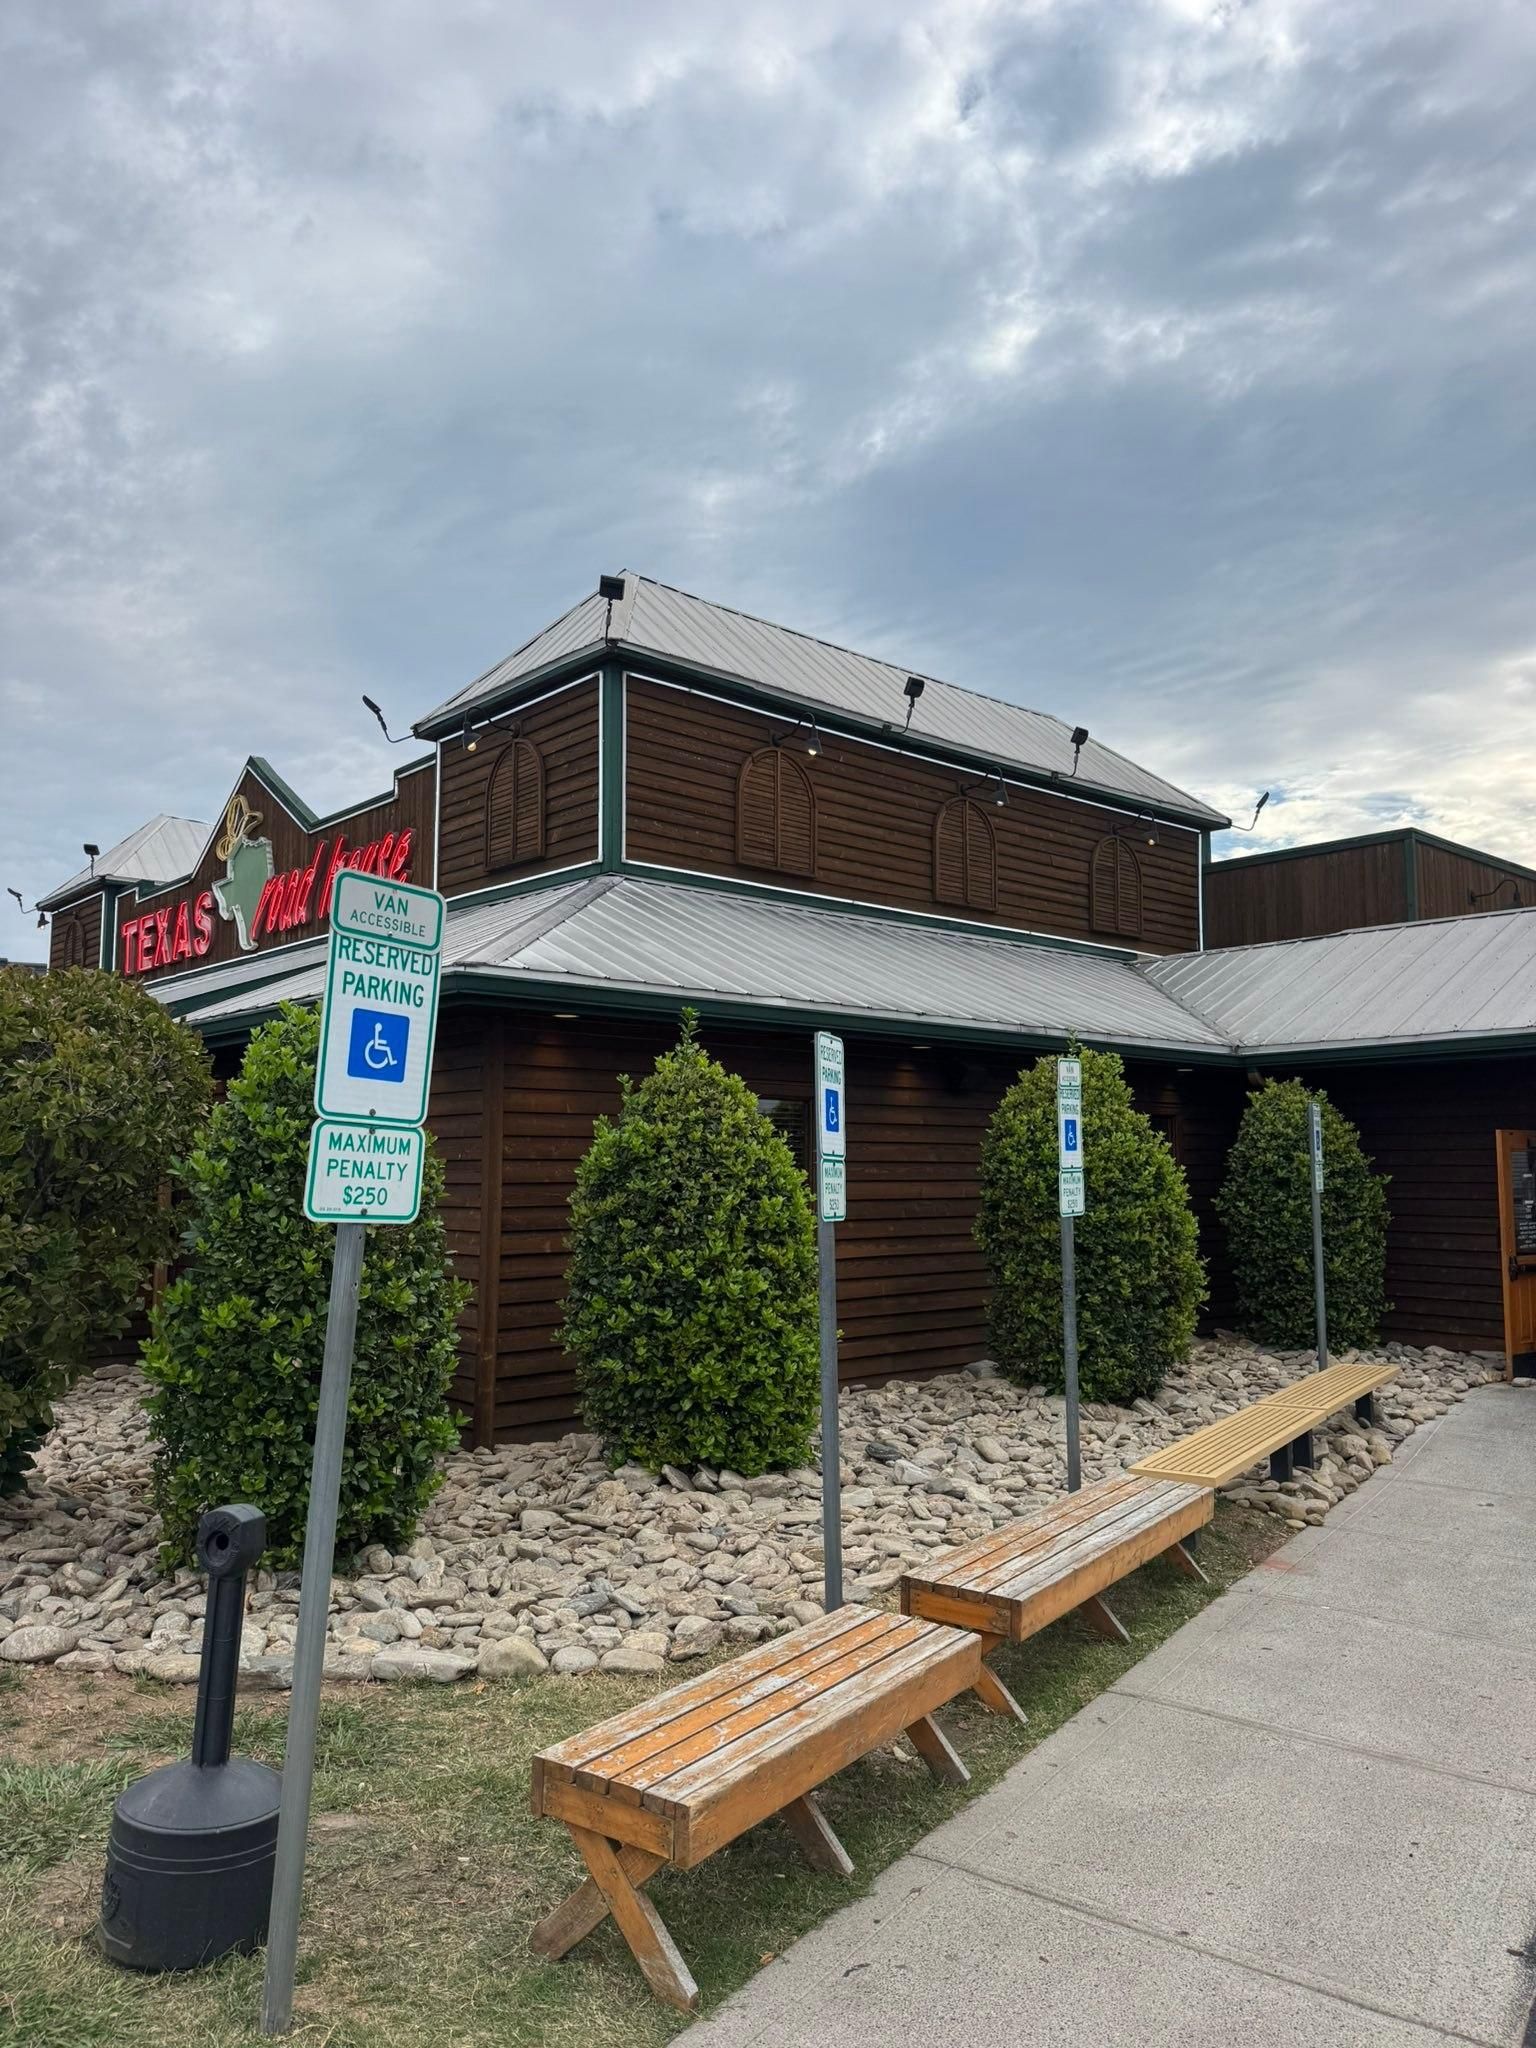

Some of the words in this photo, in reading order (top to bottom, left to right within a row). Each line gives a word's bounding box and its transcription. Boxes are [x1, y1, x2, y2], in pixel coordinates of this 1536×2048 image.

[374, 891, 408, 916] VAN
[121, 890, 214, 976] TEXAS
[350, 909, 426, 937] ACCESSIBLE
[338, 935, 433, 976] RESERVED
[342, 971, 425, 1008] PARKING
[820, 1045, 842, 1064] RESERVED
[822, 1066, 841, 1085] PARKING
[328, 1131, 411, 1156] MAXIMUM
[326, 1158, 408, 1182] PENALTY
[824, 1167, 843, 1179] MAXIMUM
[342, 1185, 388, 1207] $250
[825, 1182, 843, 1194] PENALTY
[1063, 1187, 1081, 1197] PENALTY
